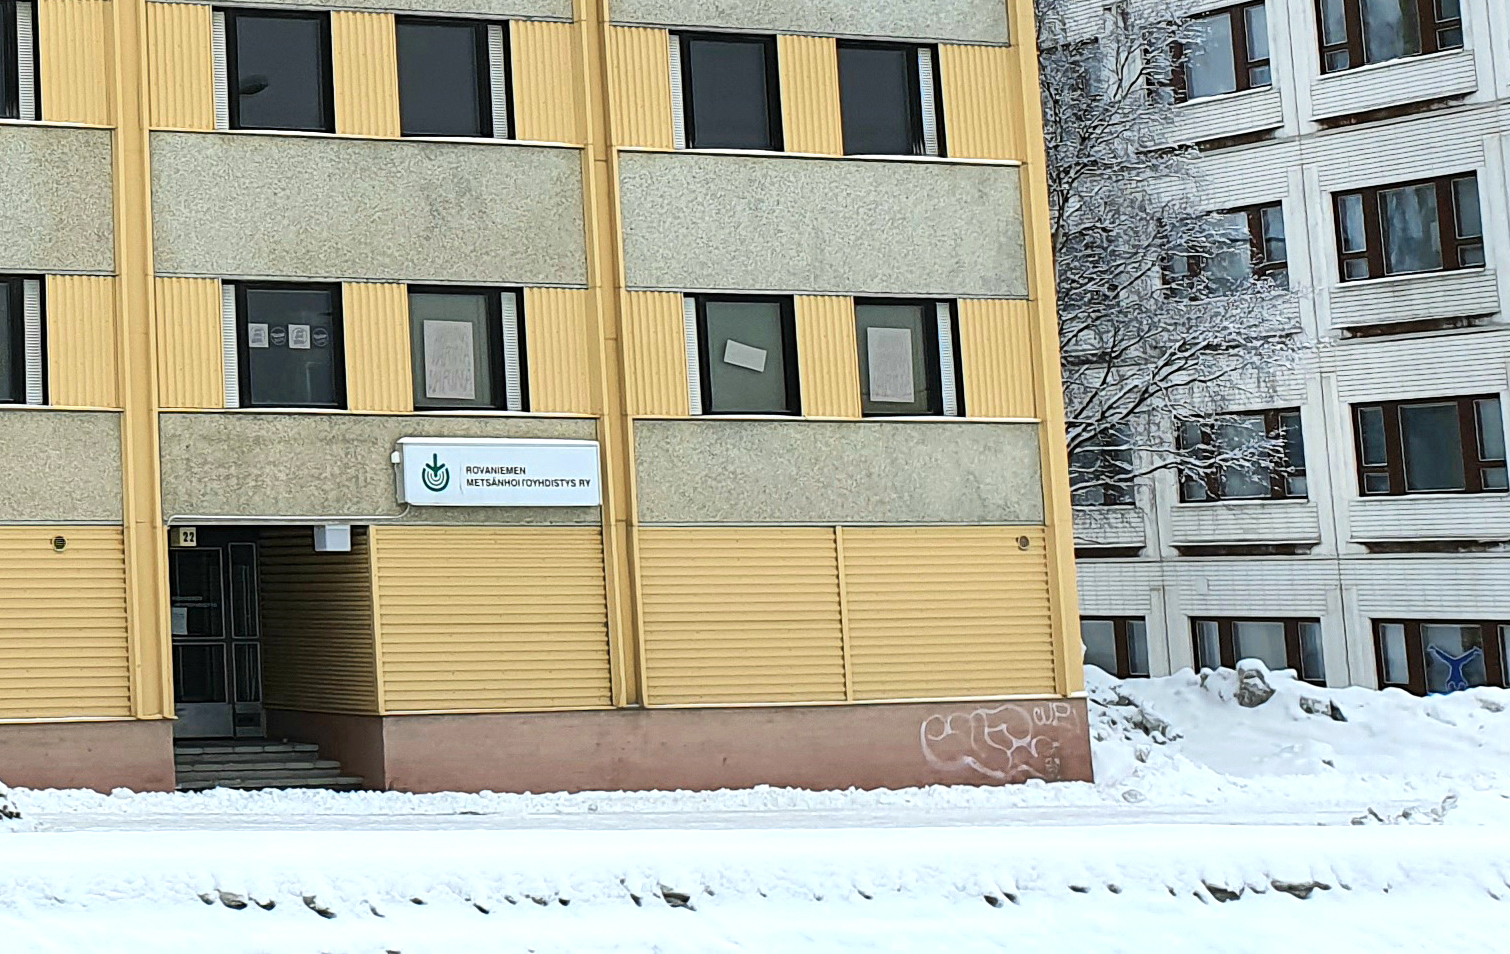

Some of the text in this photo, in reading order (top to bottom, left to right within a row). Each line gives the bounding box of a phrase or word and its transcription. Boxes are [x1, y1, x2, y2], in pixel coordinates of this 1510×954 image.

[465, 466, 526, 475] ROVANIEMEN
[466, 477, 591, 487] METSÄNHOITOYHDISTYS RY
[182, 531, 195, 543] 22
